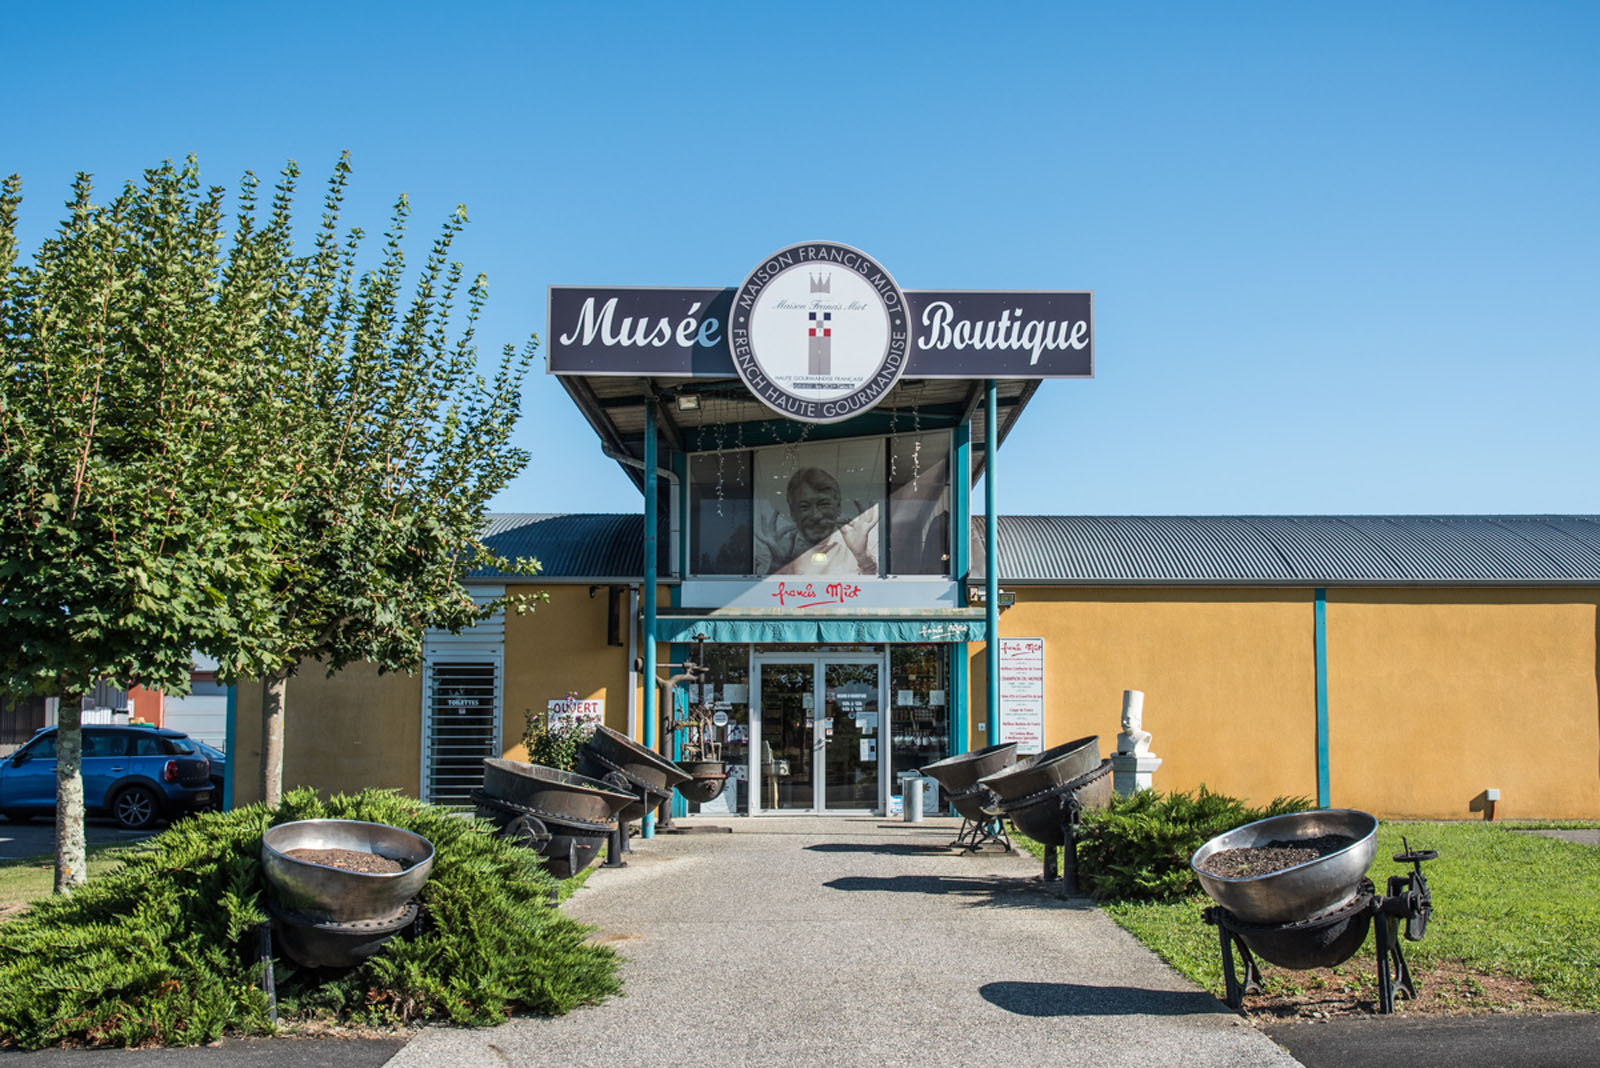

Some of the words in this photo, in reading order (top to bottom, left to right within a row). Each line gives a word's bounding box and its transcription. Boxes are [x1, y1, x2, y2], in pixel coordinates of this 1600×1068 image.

[740, 252, 793, 309] MAISON
[799, 247, 871, 274] FRANCIS
[871, 273, 902, 313] MIOT
[559, 297, 722, 348] Musée
[918, 301, 1089, 365] Boutique
[734, 329, 767, 389] FRENCH
[765, 389, 816, 416] HAUTE
[824, 331, 906, 417] GOURMANDISE
[825, 582, 862, 603] Miot
[553, 702, 598, 713] OUVERT
